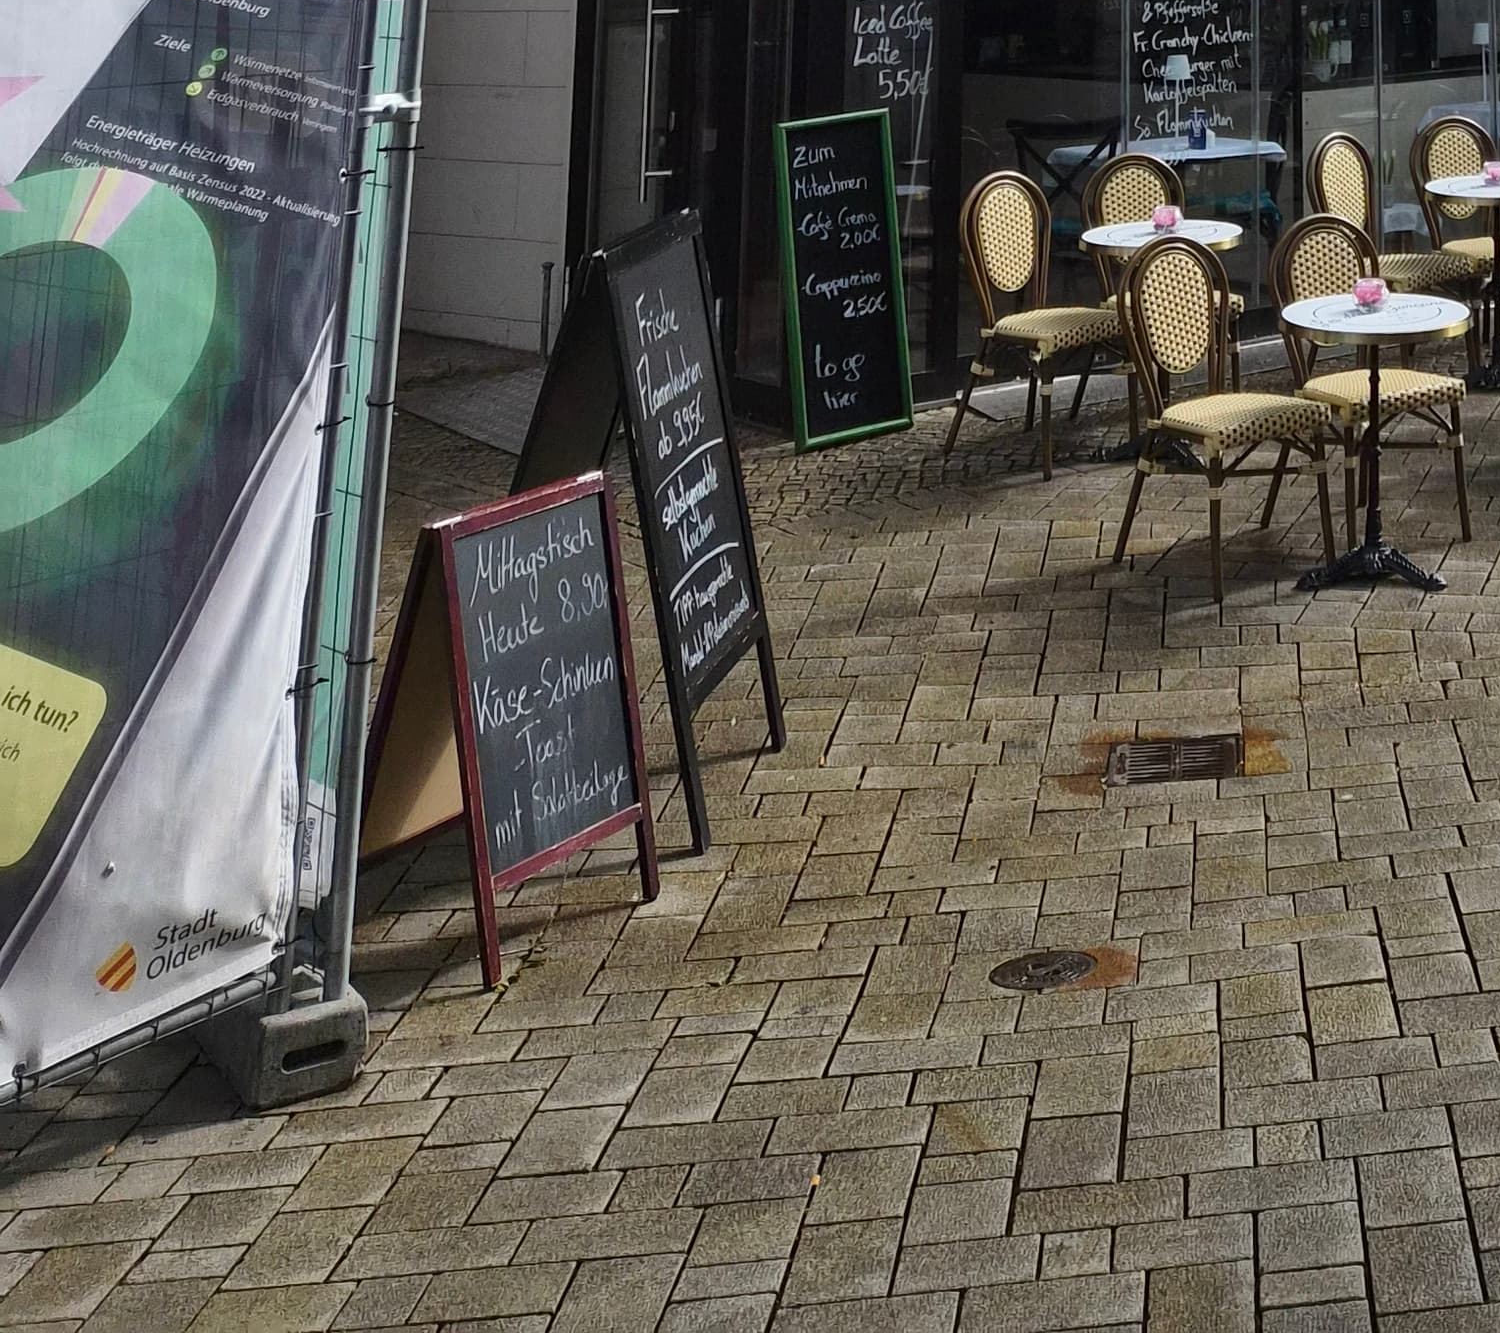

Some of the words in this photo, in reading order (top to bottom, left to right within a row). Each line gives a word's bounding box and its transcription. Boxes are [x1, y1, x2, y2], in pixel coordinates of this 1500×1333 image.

[853, 5, 886, 35] Iced
[889, 1, 934, 40] Coffee
[153, 34, 192, 53] Ziele
[853, 36, 901, 67] Latte
[1221, 49, 1242, 70] mit
[233, 53, 303, 81] Wärmenetze
[878, 68, 929, 101] 5,50€
[206, 88, 299, 122] Erdgasverbrauch
[220, 70, 320, 108] Wärmeversorgung
[60, 151, 86, 169] folgt
[85, 115, 178, 154] Energieträger
[178, 141, 256, 174] Heizungen
[793, 145, 835, 168] Zum
[72, 137, 148, 171] Hochrechnung
[148, 162, 170, 174] auf
[169, 165, 196, 183] Basis
[197, 173, 238, 194] Zensus
[239, 185, 266, 201] 2022
[272, 194, 341, 227] Aktualisierung
[794, 171, 868, 201] Mitnehmen
[186, 189, 269, 223] Wärmeplanung
[838, 206, 877, 227] Crema
[635, 288, 679, 347] Frische
[636, 345, 703, 421] Flammkuchen
[842, 354, 865, 382] go
[823, 390, 858, 410] hier
[658, 420, 672, 460] ab
[661, 454, 719, 531] selbstgemachte
[678, 508, 717, 563] Kuchen
[469, 516, 595, 608] Mittagstisch
[478, 602, 544, 664] Heute
[1, 686, 30, 715] ich
[33, 701, 79, 733] tun?
[472, 651, 614, 734] Käse-Schinken
[494, 789, 522, 850] mit
[531, 760, 629, 821] Salatbeilage
[146, 911, 266, 979] Oldenburg
[154, 908, 218, 951] Stadt
